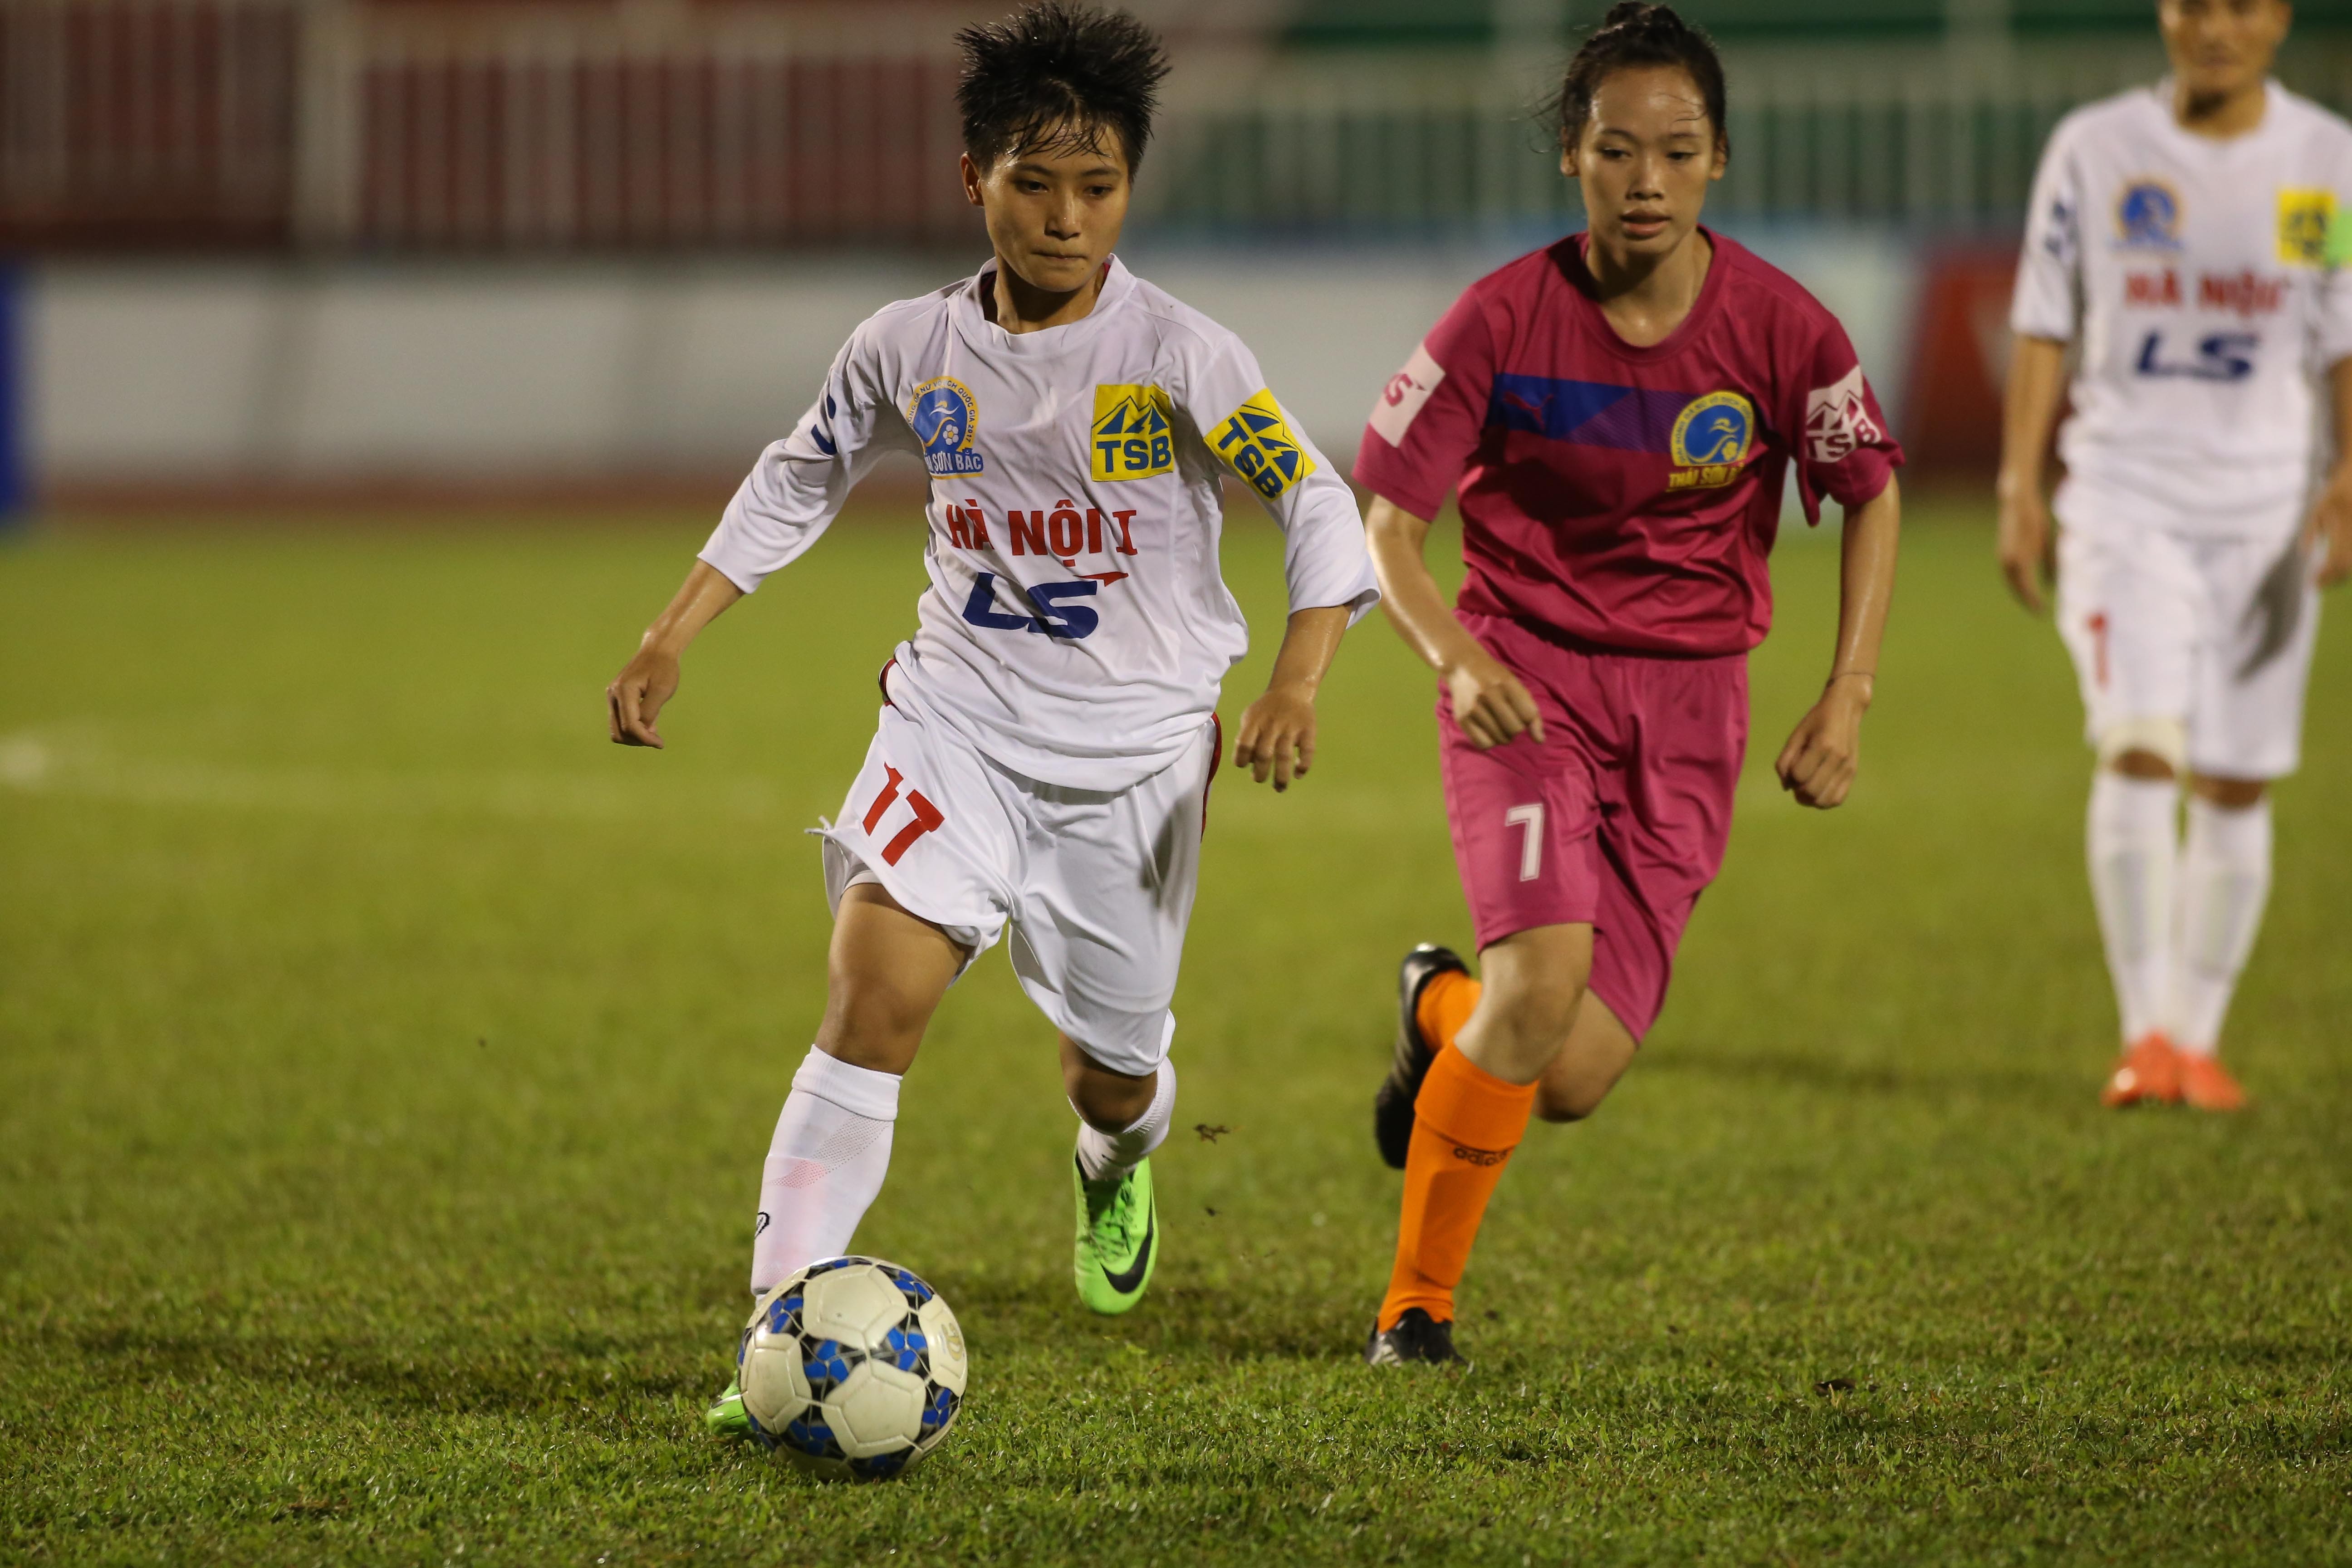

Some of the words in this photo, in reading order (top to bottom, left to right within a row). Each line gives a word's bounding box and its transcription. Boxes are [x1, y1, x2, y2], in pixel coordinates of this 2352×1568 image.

[2137, 330, 2260, 383] LS
[932, 451, 953, 472] SƠN
[955, 450, 981, 470] BẮC
[1097, 436, 1171, 473] TSB
[1218, 416, 1284, 498] TSB
[1807, 418, 1877, 459] TSB
[946, 499, 995, 550] HÀ
[1008, 499, 1102, 567] NỘI
[1112, 510, 1138, 556] I
[962, 572, 1099, 639] LS
[862, 761, 946, 867] 17
[1504, 803, 1545, 882] 7
